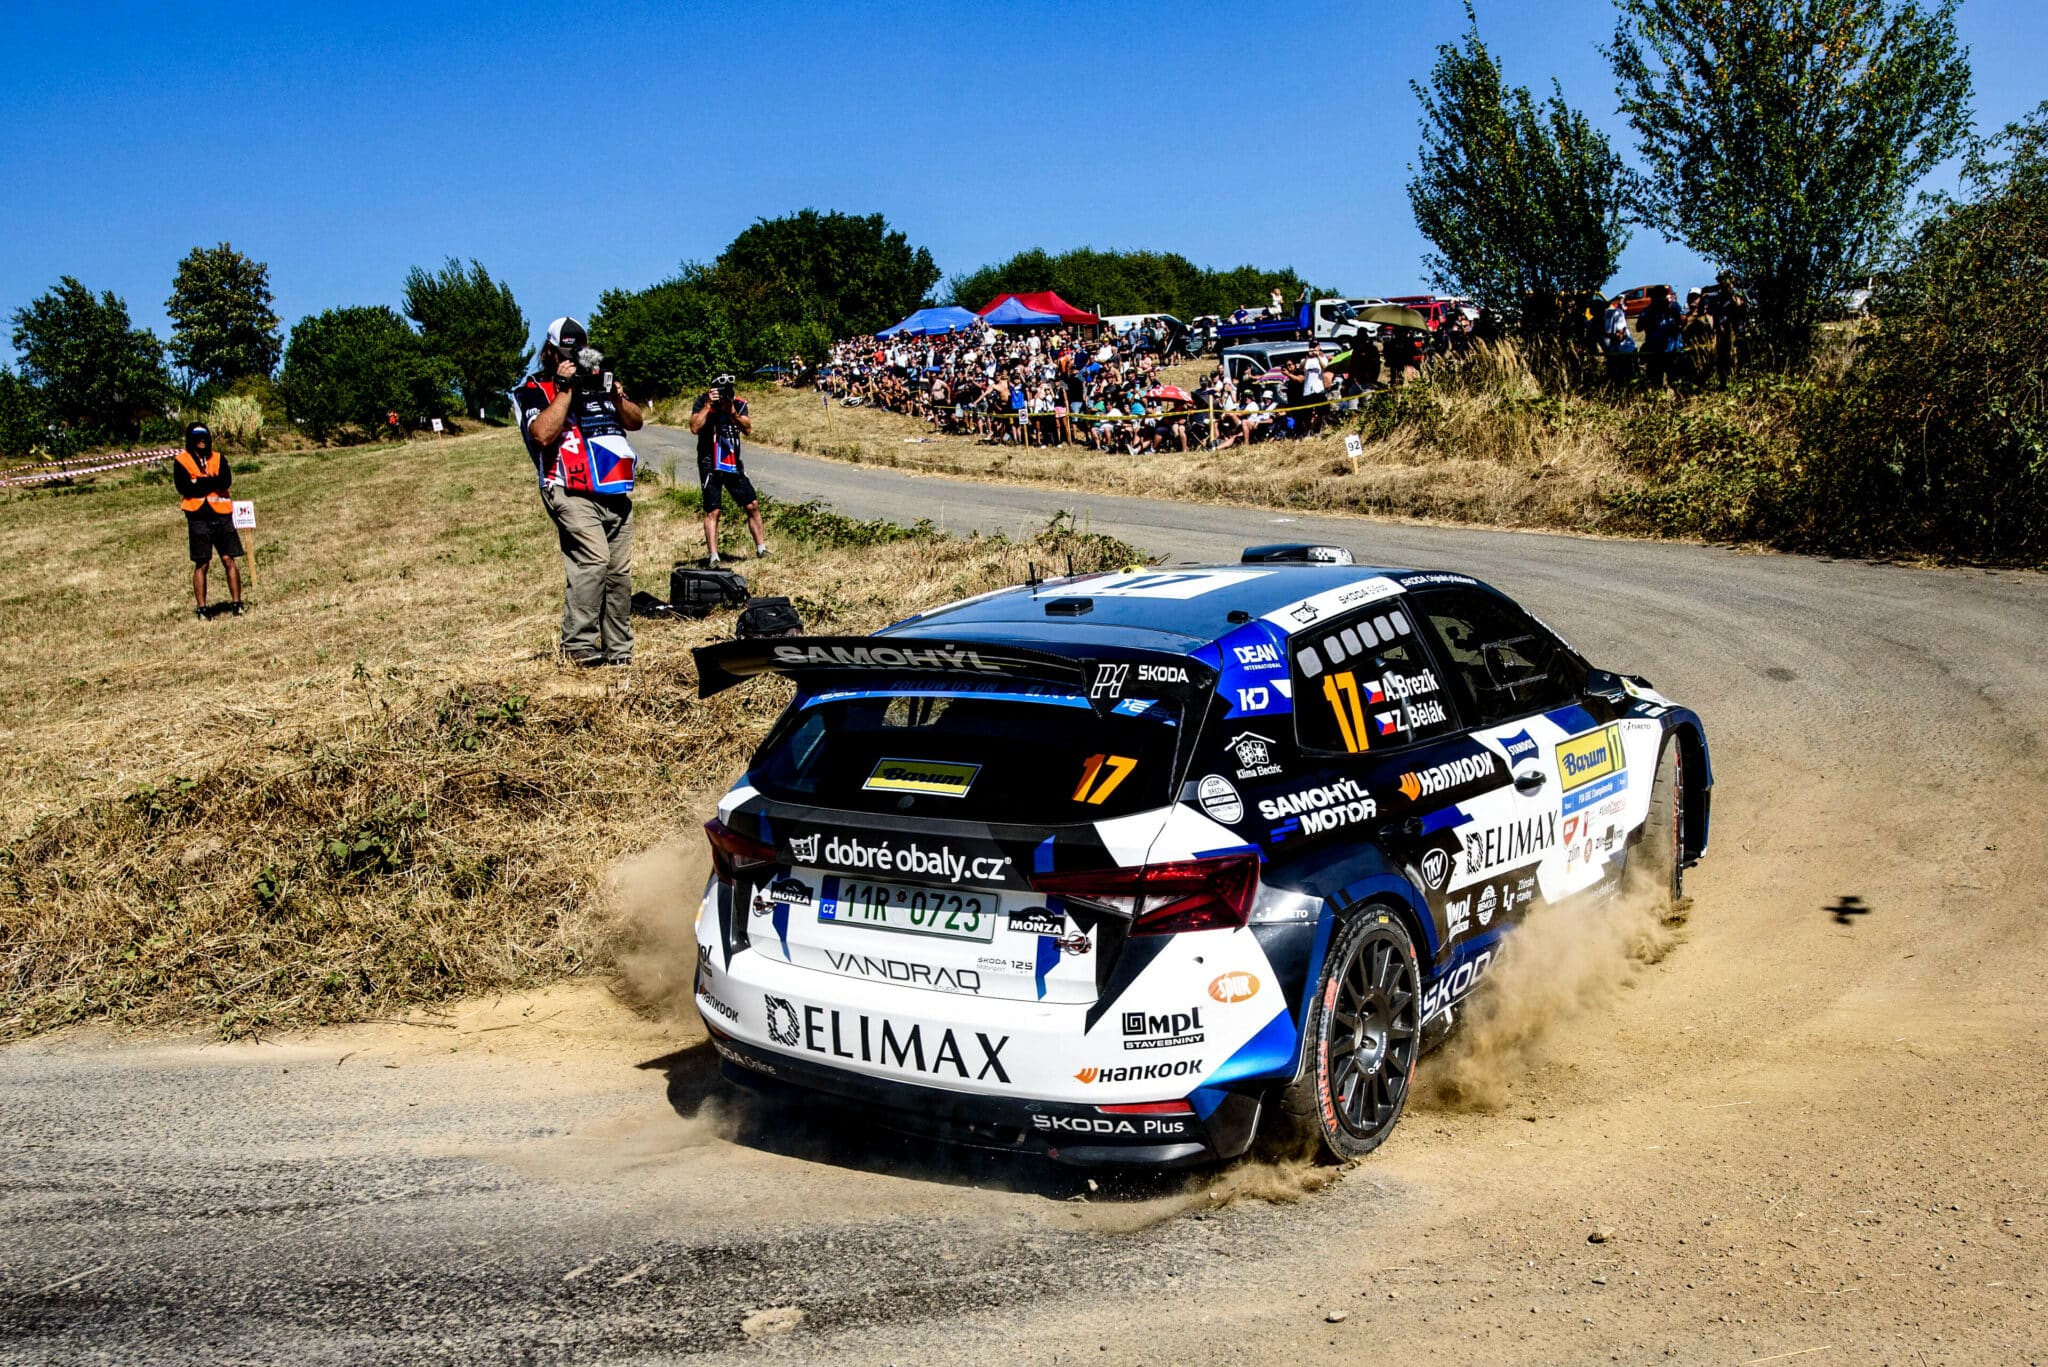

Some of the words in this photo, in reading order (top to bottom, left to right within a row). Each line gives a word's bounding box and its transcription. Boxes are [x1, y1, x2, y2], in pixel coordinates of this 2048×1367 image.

[1347, 440, 1361, 452] 92
[774, 644, 1001, 671] SAMOHÝL
[1233, 643, 1280, 664] DEAN
[1243, 663, 1282, 672] INTERNATIONAL
[1323, 671, 1370, 752] 17
[1407, 700, 1447, 728] Bělák
[1257, 763, 1283, 776] Electric
[1562, 745, 1607, 776] Barum
[882, 767, 965, 785] Barum
[1072, 753, 1138, 805] 17
[1258, 778, 1370, 820] SAMOHÝL
[1299, 798, 1377, 836] MOTOR
[825, 836, 893, 869] dobré
[771, 891, 811, 905] MONZA
[823, 903, 835, 915] CZ
[845, 883, 890, 921] 11R
[909, 890, 982, 932] 0723
[1010, 920, 1063, 934] MONZA
[824, 949, 981, 994] VANDRAQ
[1011, 959, 1033, 971] 125
[764, 993, 1012, 1084] DELIMAX
[1125, 1035, 1203, 1049] STAVEBNINY
[1143, 1120, 1185, 1134] Plus
